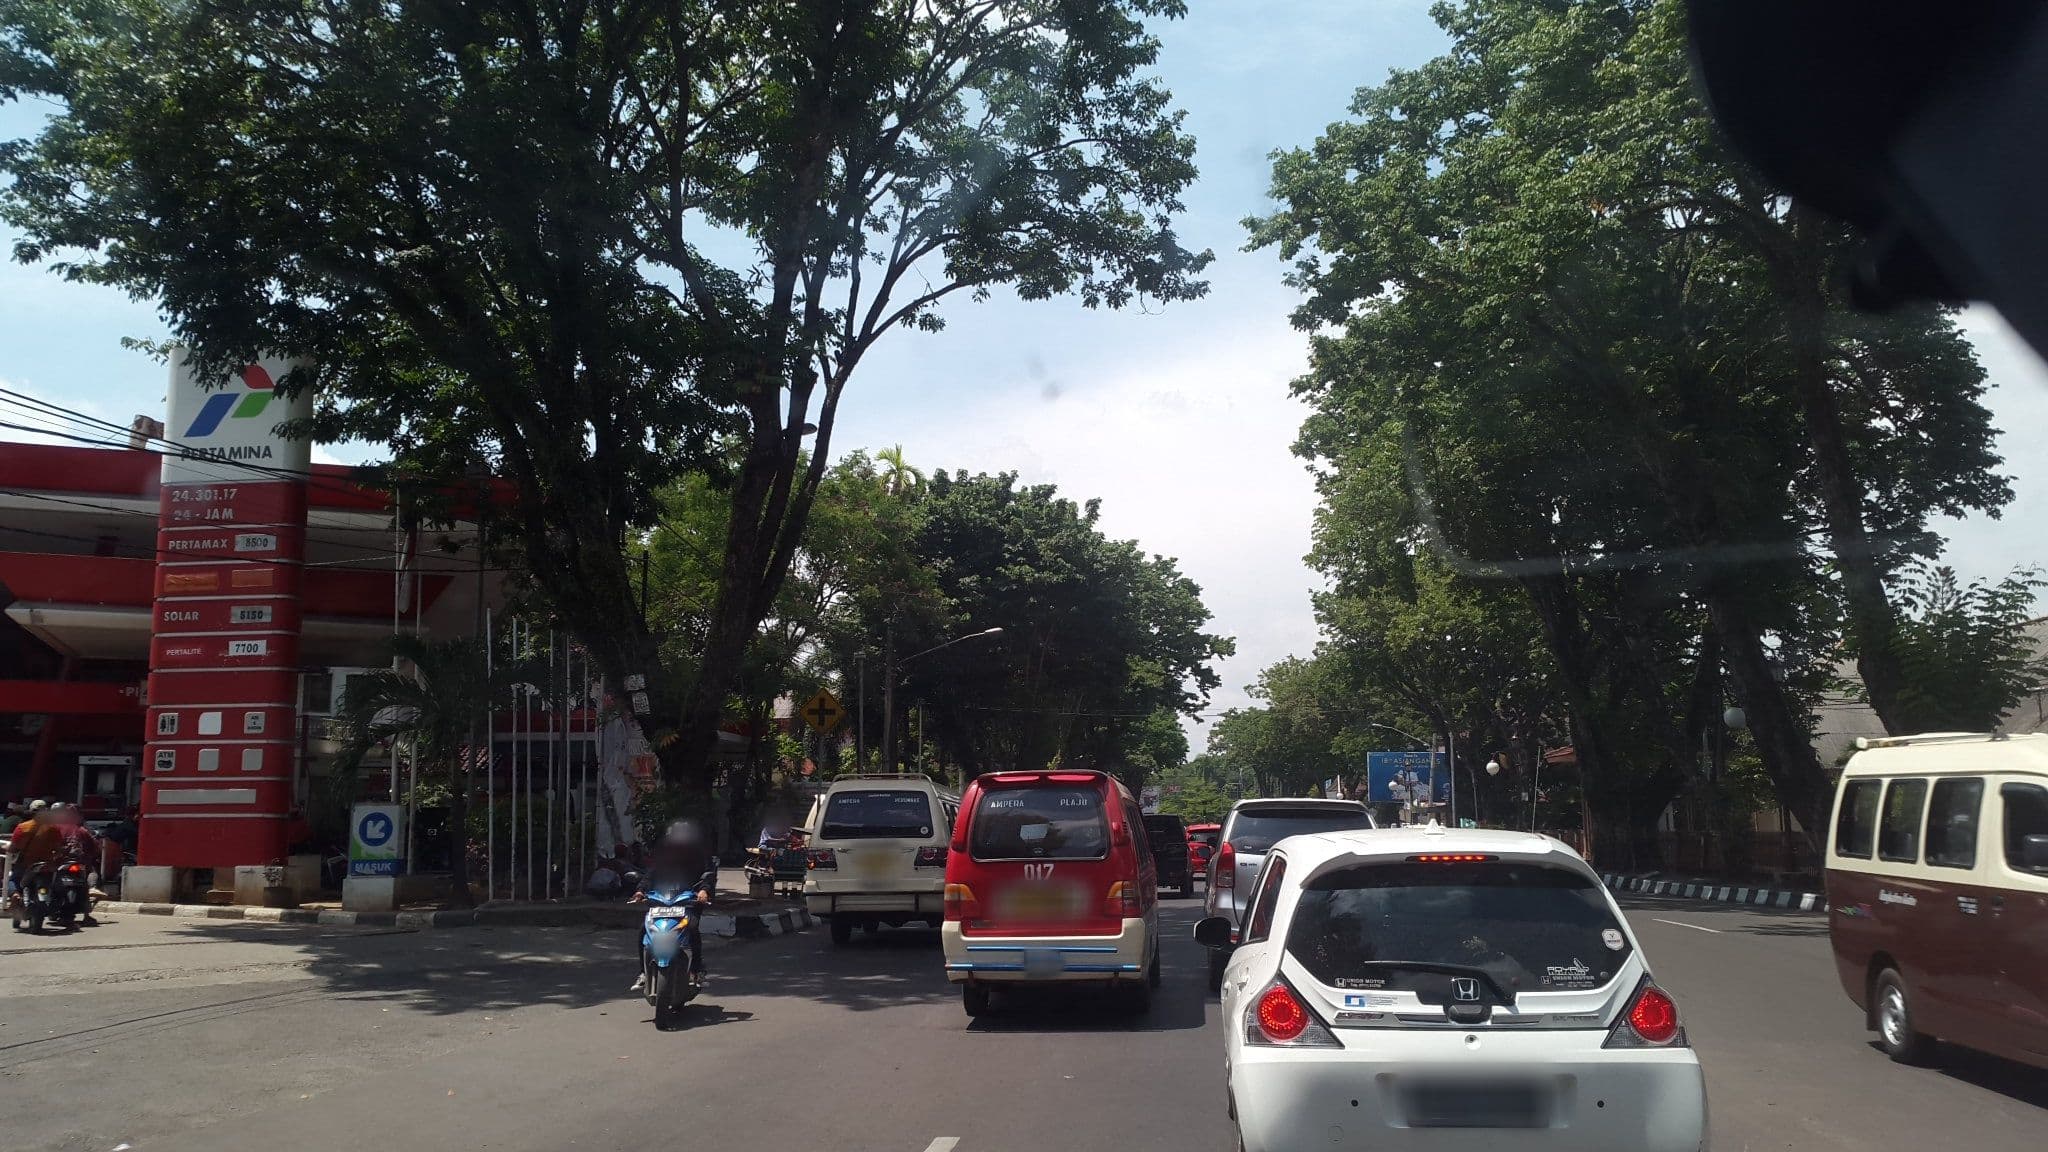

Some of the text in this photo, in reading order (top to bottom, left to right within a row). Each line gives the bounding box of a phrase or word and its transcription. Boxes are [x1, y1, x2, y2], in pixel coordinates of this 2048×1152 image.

[181, 446, 273, 461] PERTAMINA
[204, 508, 234, 520] JAM
[168, 539, 229, 550] PERTAMAX
[163, 610, 264, 621] SOLAR 5150
[166, 643, 259, 656] PERTALITE 7700
[990, 798, 1088, 808] AMPERA PLAJU
[354, 862, 392, 874] MASUK
[1024, 863, 1055, 880] 017
